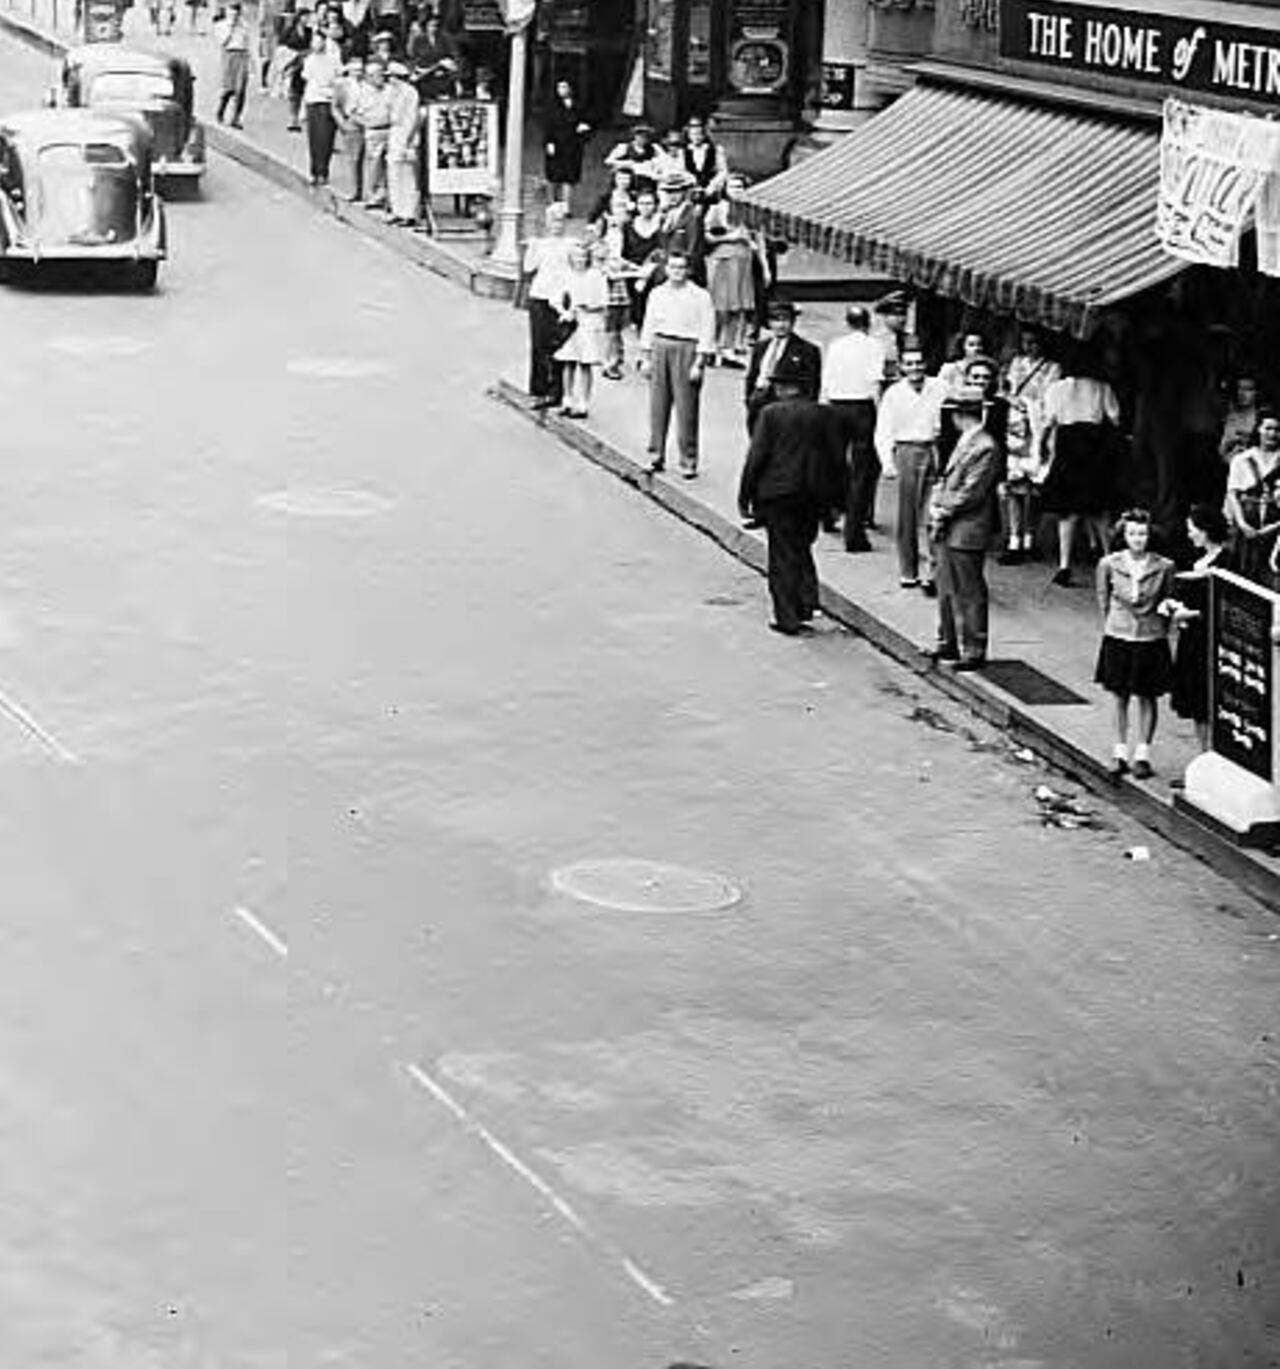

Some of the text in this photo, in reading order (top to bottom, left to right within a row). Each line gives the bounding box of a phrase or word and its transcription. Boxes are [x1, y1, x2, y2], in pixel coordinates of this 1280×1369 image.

[1027, 12, 1073, 59] THE
[1085, 20, 1162, 73] HOME
[1171, 26, 1207, 81] of
